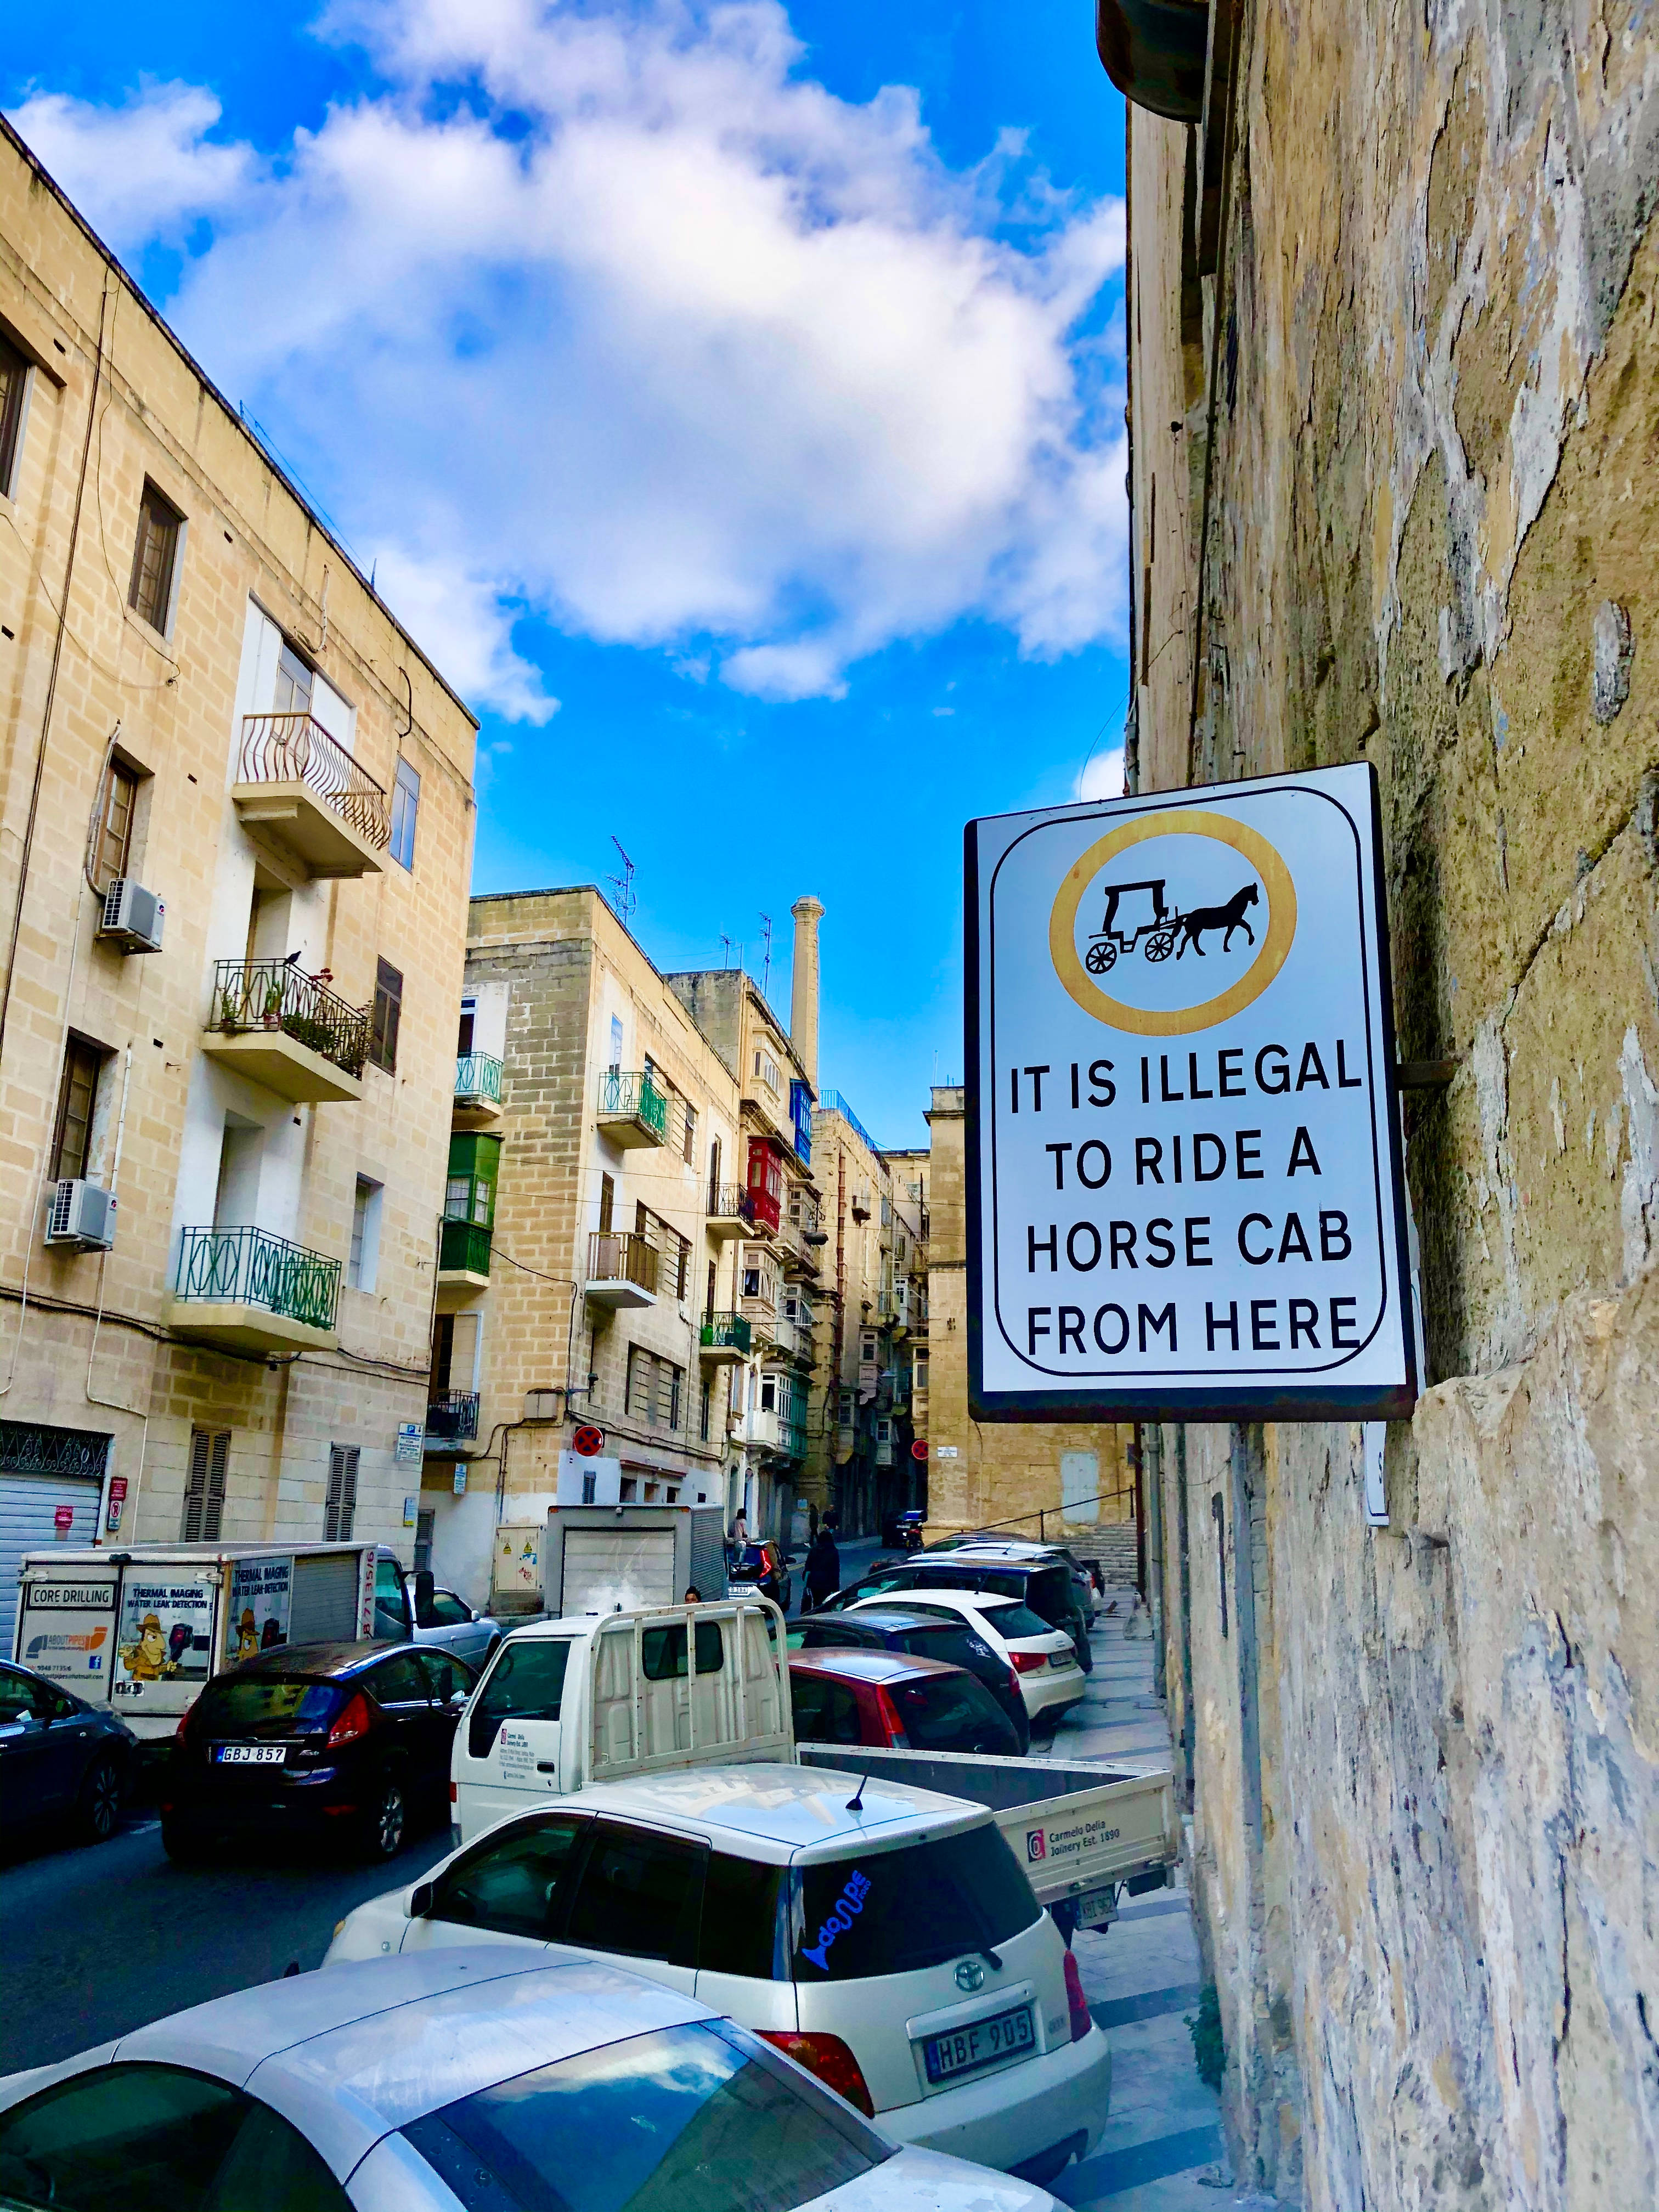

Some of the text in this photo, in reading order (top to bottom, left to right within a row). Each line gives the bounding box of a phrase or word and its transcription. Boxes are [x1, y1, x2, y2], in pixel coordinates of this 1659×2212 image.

[1012, 1040, 1362, 1113] IT IS ILLEGAL
[1046, 1126, 1322, 1189] TO RIDE A
[1028, 1210, 1352, 1273] HORSE CAB
[1028, 1297, 1360, 1356] FROM HERE
[235, 1568, 262, 1583] THERMAL
[34, 1589, 109, 1603] CORE DRILLING
[133, 1588, 204, 1598] THERMAL IMAGING
[127, 1600, 151, 1608] WATER
[154, 1600, 170, 1609] LEAK
[172, 1600, 207, 1609] DETECTION
[224, 1748, 251, 1760] GBJ
[256, 1748, 284, 1761] 857
[1049, 1826, 1083, 1843] Carmelo
[1051, 1841, 1080, 1857] Joinery
[1101, 1829, 1120, 1842] 1890
[858, 1880, 872, 1899] 2020
[939, 2030, 979, 2069] HBF
[989, 2015, 1029, 2051] 905
